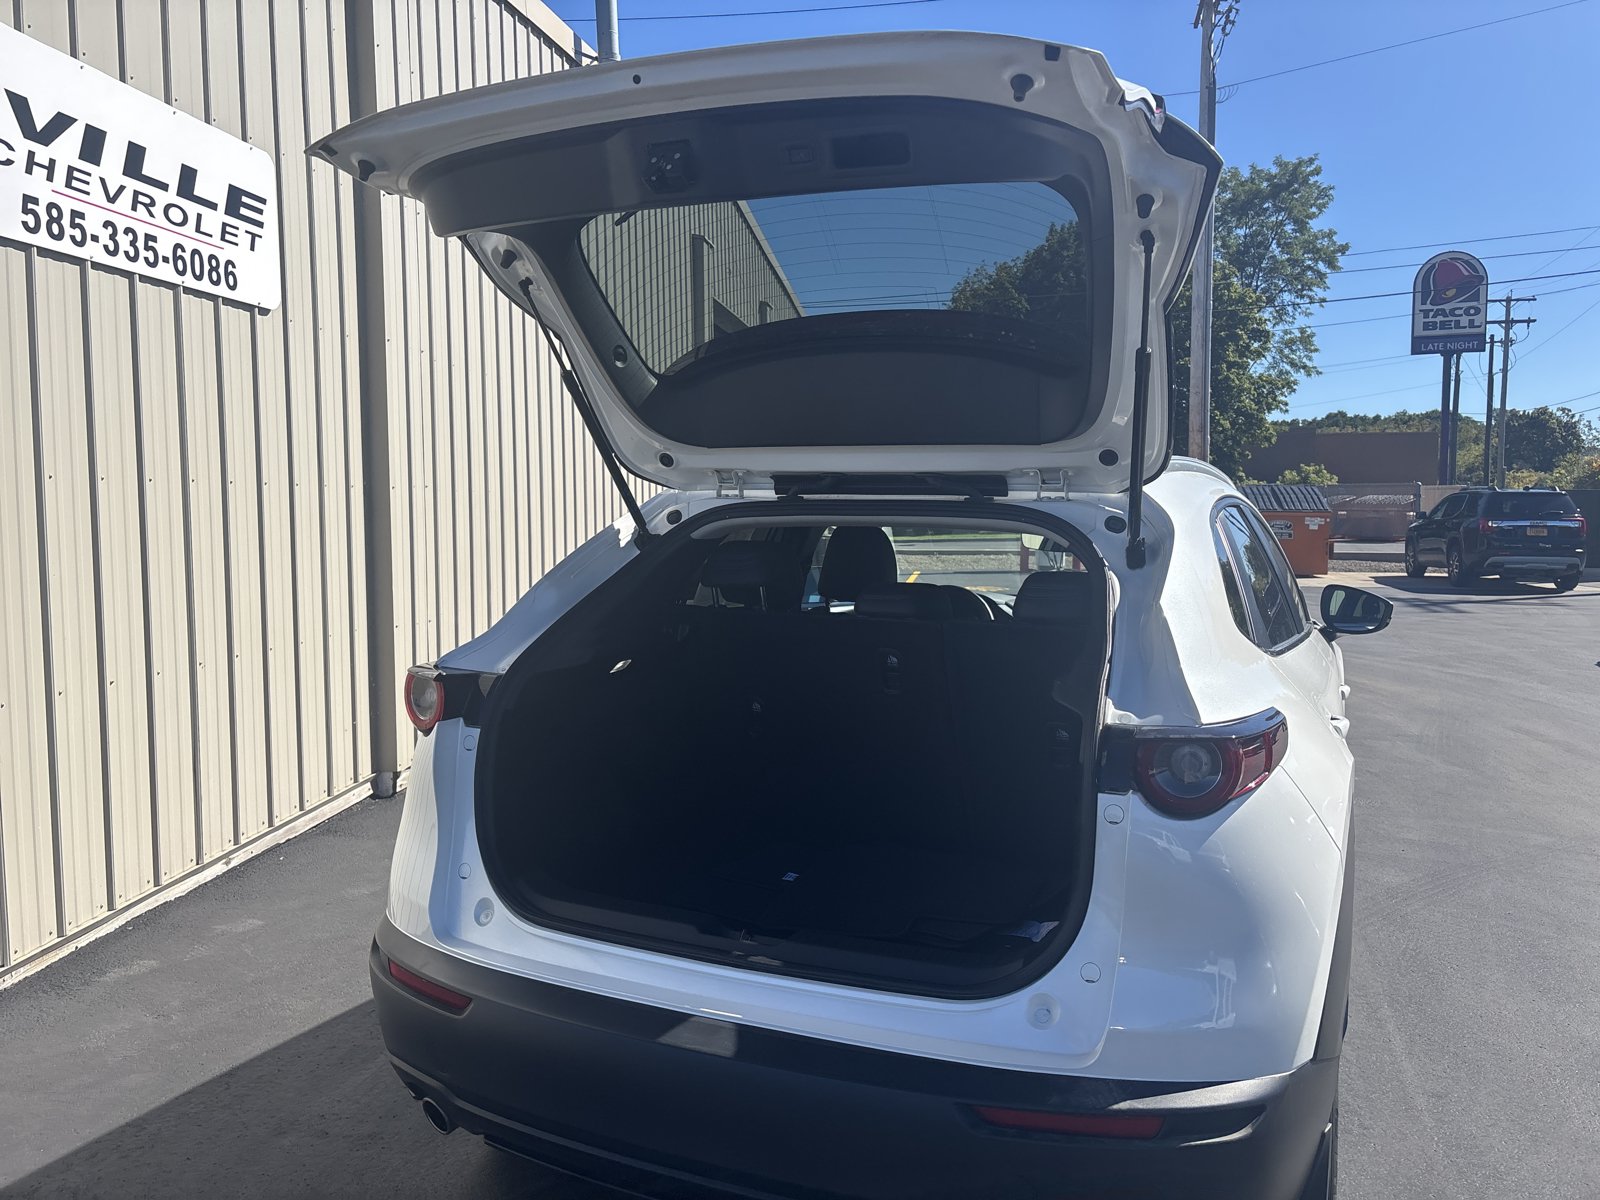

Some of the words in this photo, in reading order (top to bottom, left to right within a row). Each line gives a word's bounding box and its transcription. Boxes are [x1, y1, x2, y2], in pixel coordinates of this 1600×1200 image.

[4, 88, 267, 229] VILLE
[20, 193, 238, 291] 585-335-6086
[1419, 306, 1481, 319] TACO
[1422, 319, 1483, 331] BELL
[1421, 343, 1444, 351] LATE
[1447, 341, 1478, 350] NIGHT
